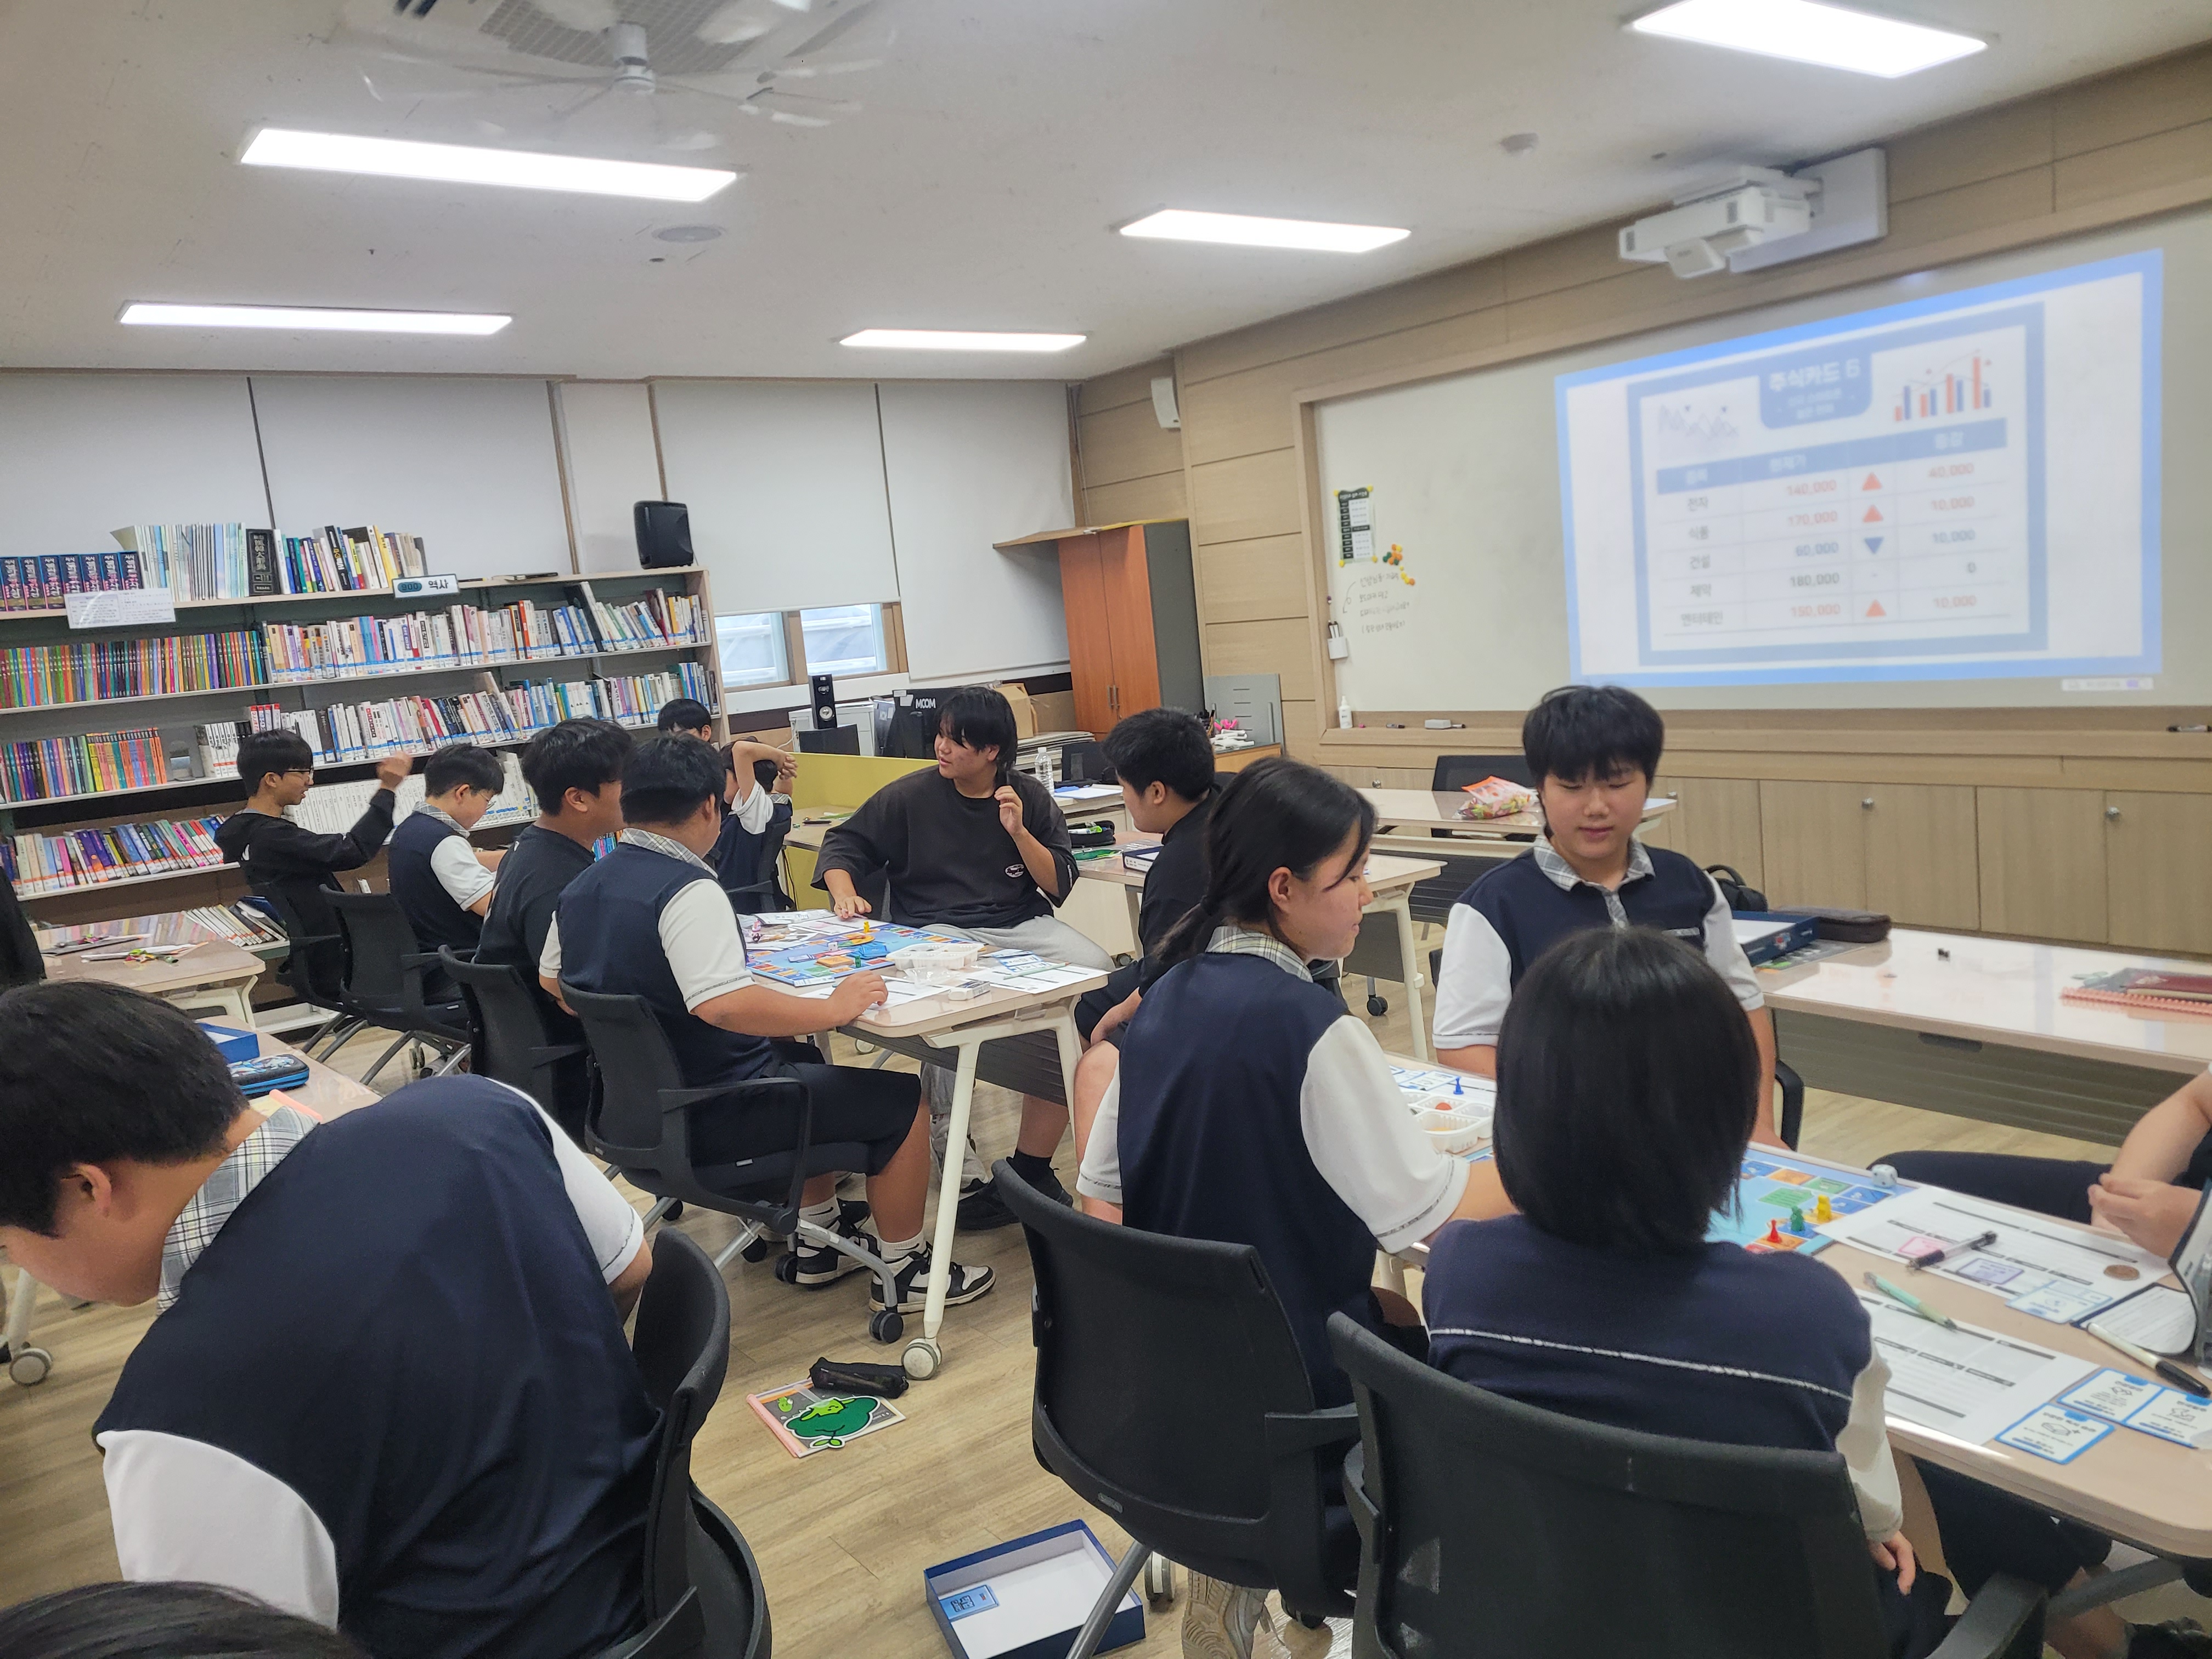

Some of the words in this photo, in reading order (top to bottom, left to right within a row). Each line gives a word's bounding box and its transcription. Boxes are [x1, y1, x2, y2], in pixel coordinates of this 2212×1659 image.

[1769, 362, 1840, 392] 주식카드
[1846, 358, 1860, 378] 6
[1688, 496, 1708, 512] 전자
[402, 582, 419, 591] 900
[428, 579, 448, 590] 역사
[1790, 572, 1839, 588] 180,000
